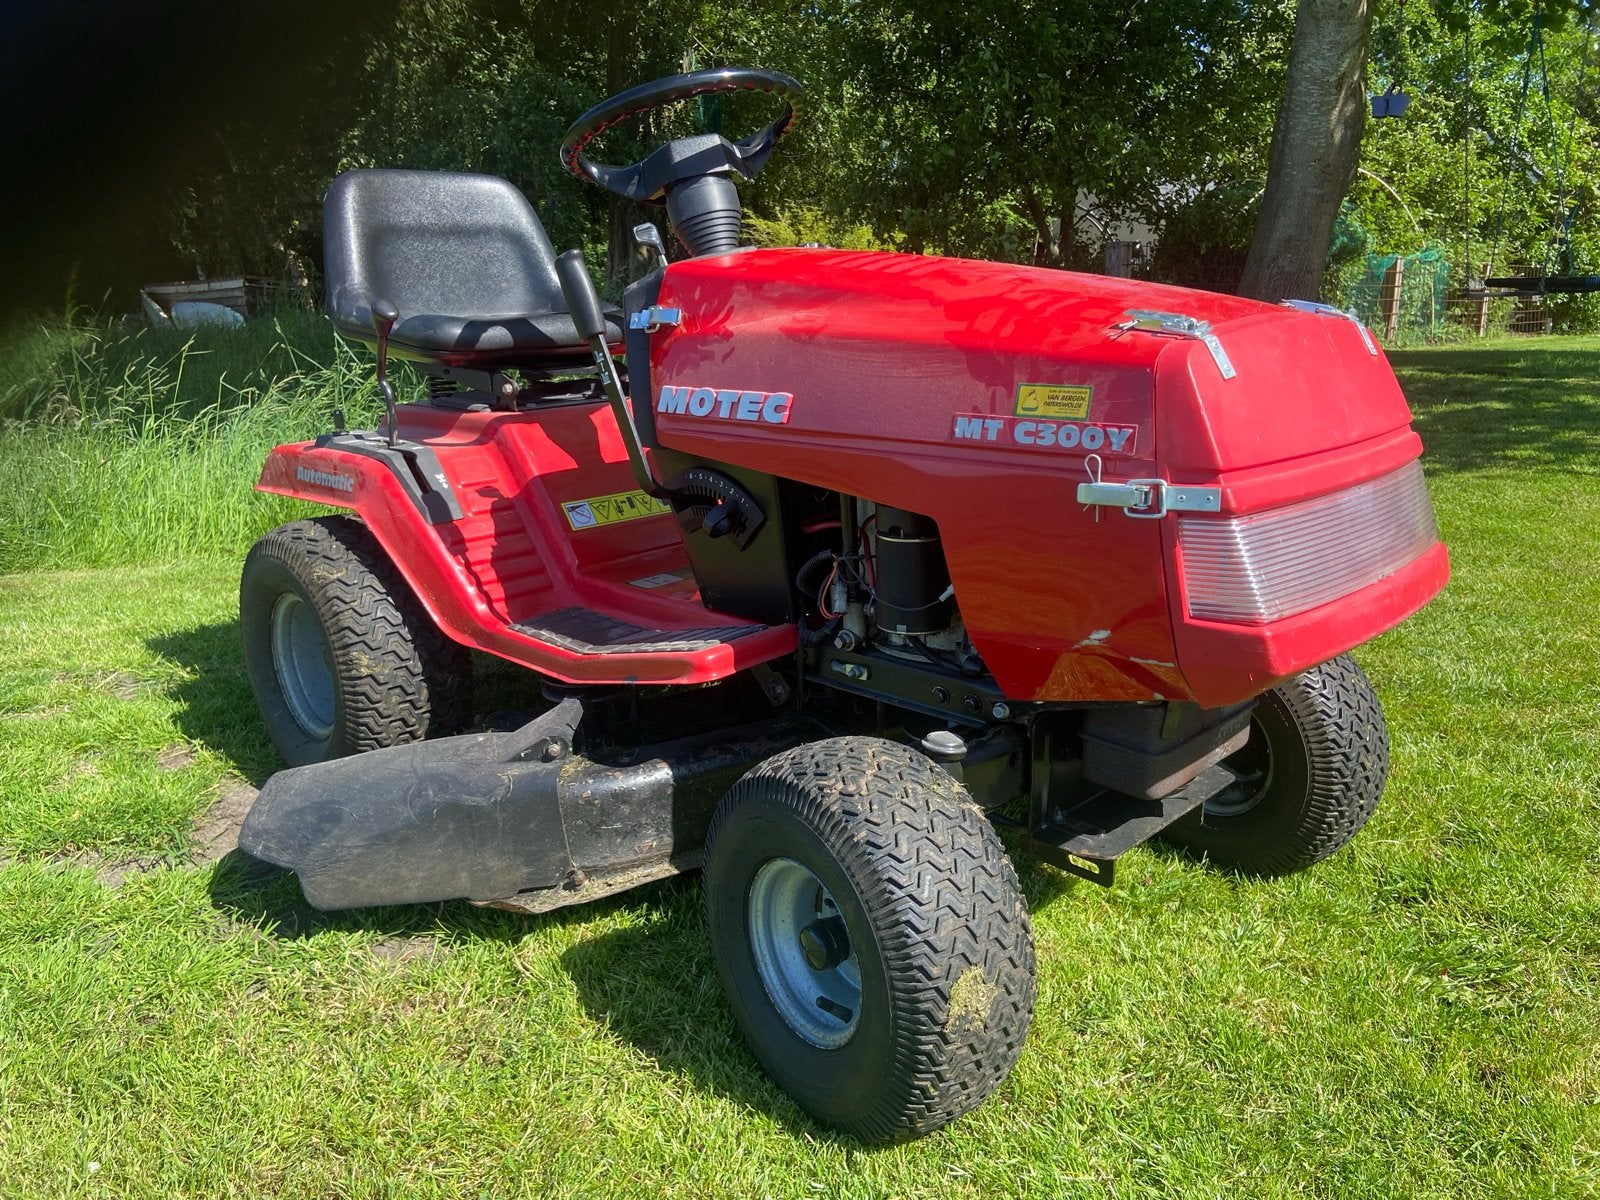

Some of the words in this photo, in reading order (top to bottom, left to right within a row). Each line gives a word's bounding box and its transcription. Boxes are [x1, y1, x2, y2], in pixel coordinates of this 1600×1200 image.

[657, 385, 793, 424] MOTEC
[1043, 401, 1083, 409] PATERSWOLDE
[954, 417, 1003, 441] MT
[1013, 421, 1133, 451] C300Y
[296, 464, 354, 492] Automatic
